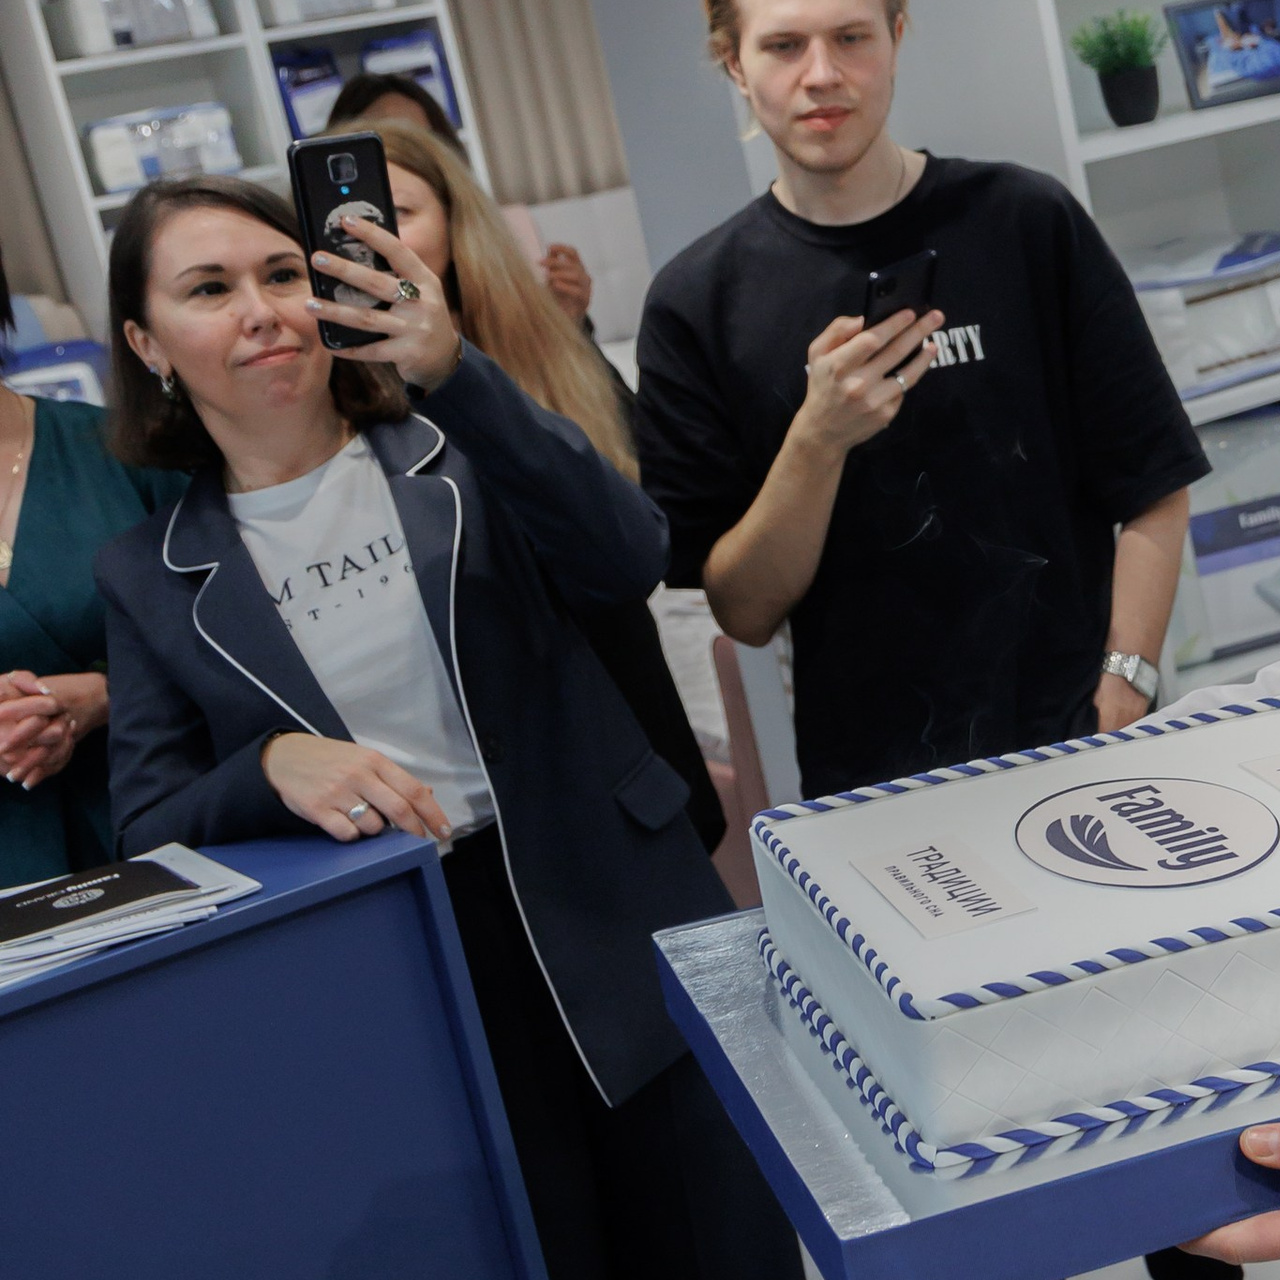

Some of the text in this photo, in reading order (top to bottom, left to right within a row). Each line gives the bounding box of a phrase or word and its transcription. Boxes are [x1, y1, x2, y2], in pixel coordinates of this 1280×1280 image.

[1096, 784, 1239, 871] Family
[885, 865, 944, 918] ПРАВИЛЬНОГО СНА
[906, 845, 1002, 917] ТРАДИЦИИ
